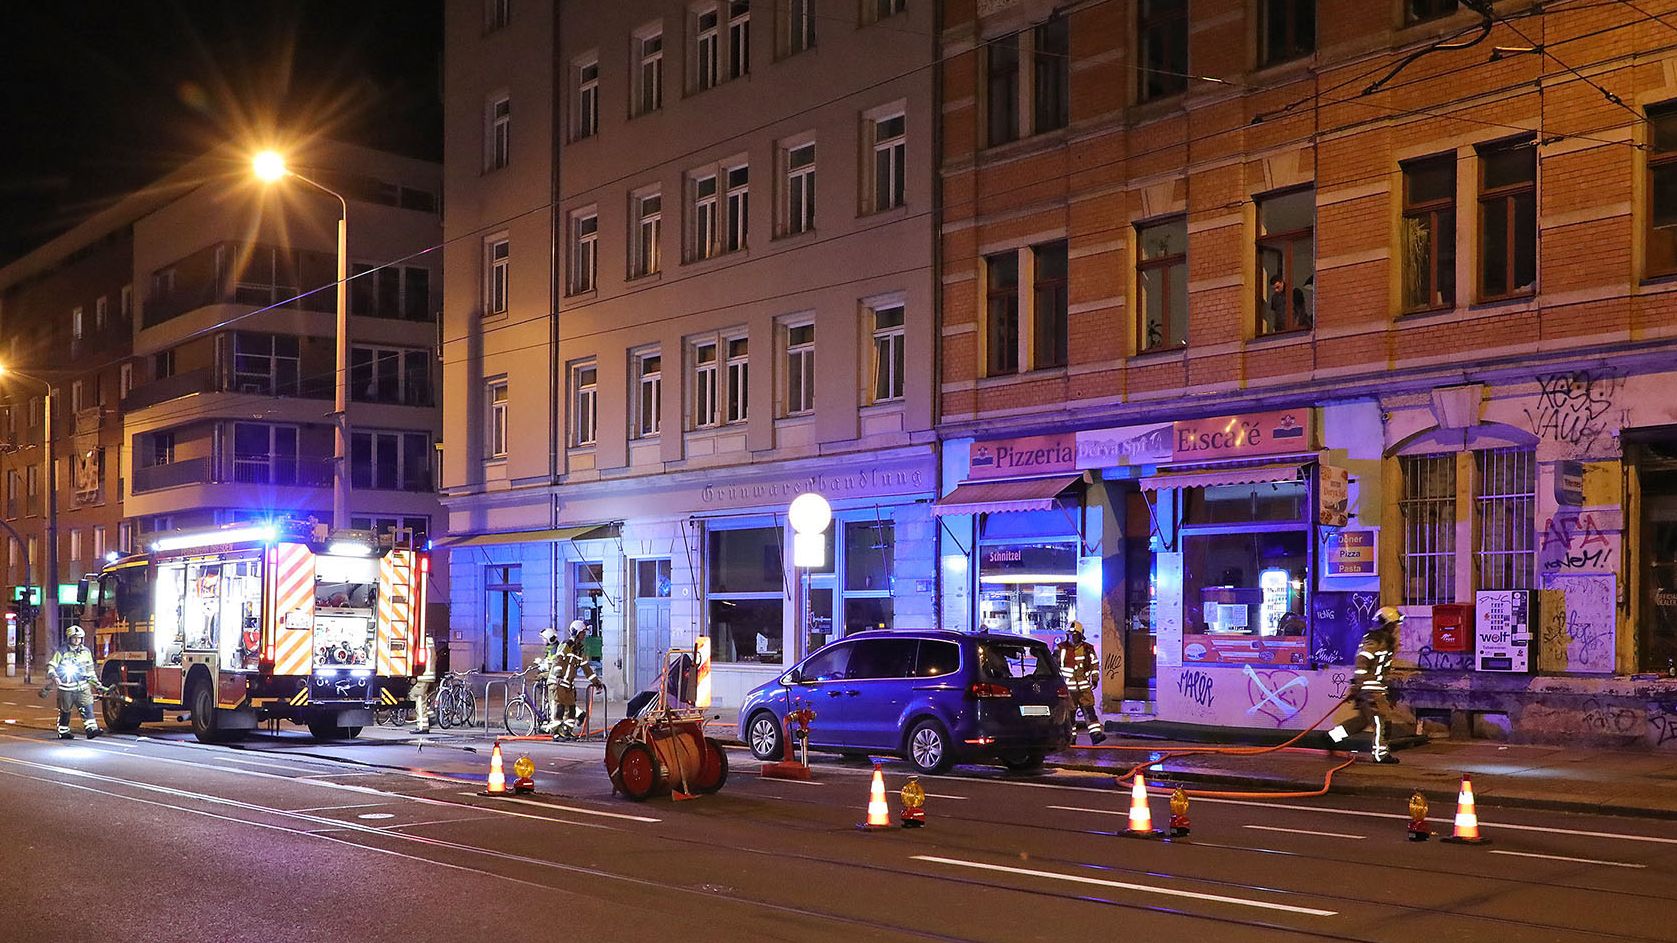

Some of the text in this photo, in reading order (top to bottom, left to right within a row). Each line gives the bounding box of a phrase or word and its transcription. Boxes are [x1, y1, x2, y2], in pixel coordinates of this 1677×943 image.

[1177, 421, 1261, 453] Eiscafé
[995, 441, 1073, 470] Pizzeria
[989, 550, 1022, 563] Schnitzel
[1339, 550, 1361, 558] Pizza
[1338, 565, 1362, 573] Pasta
[1479, 631, 1511, 643] wolf
